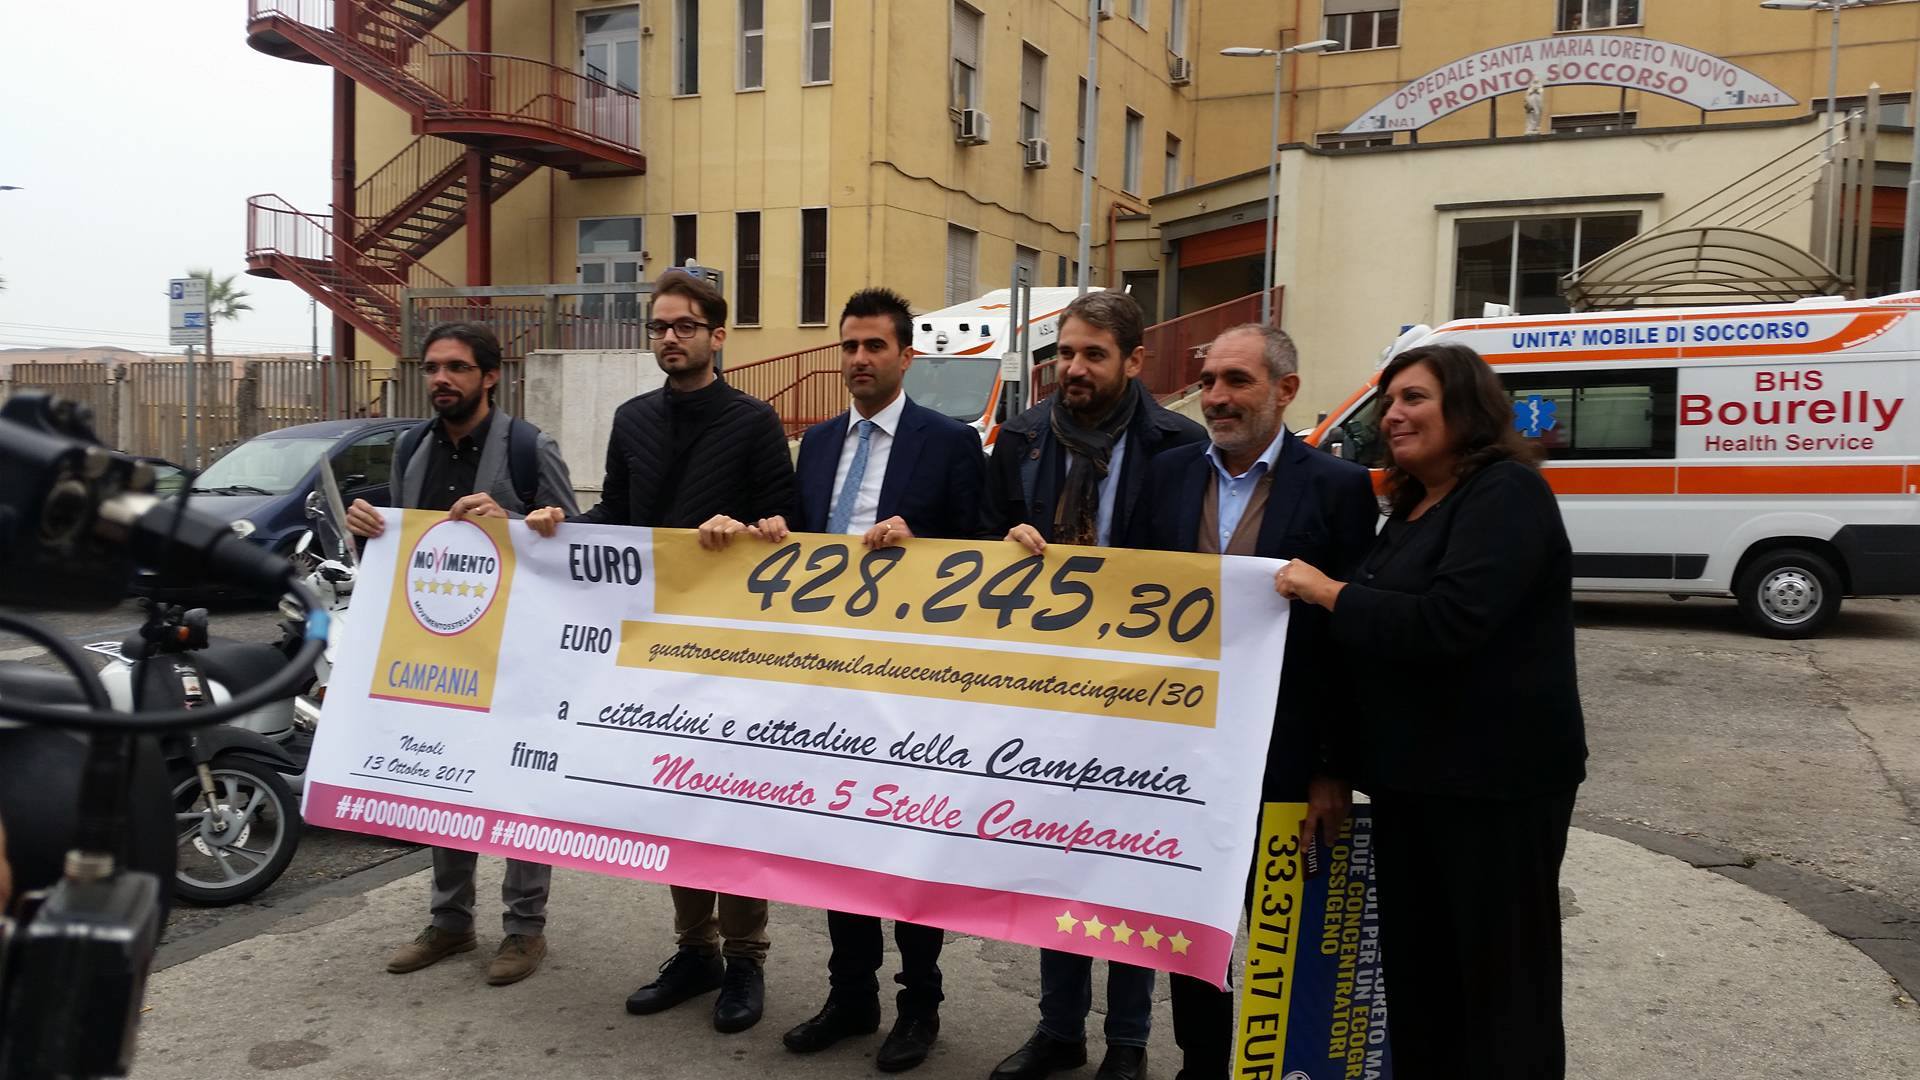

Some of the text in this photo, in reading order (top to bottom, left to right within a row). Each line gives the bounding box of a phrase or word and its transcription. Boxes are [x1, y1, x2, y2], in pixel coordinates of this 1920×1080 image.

[1395, 38, 1737, 109] OSPEDALE SANTA MARIA LORETO NUOVO
[1429, 61, 1688, 115] PRONTO SOCCORSO
[1583, 326, 1659, 346] MOBILE
[1666, 325, 1686, 342] DI
[1693, 321, 1809, 342] SOCCORSO
[1755, 370, 1824, 392] BHS
[1679, 390, 1904, 432] Bourelly
[1705, 433, 1875, 452] Health Service
[414, 546, 496, 575] MOVIMENTO
[569, 542, 1215, 643] EURO 428.245,30
[560, 623, 612, 654] EURO
[388, 660, 478, 697] CAMPANIA
[400, 734, 446, 755] Napoli
[558, 700, 1191, 795] a cittadini e cittadine della Campania
[363, 755, 475, 784] 13 Ottobre 2017
[511, 742, 1183, 859] firma Movimento 5 Stelle Campania
[1250, 834, 1299, 1000] 33.377,17
[1320, 845, 1350, 956] OSSIGENO
[1328, 817, 1372, 1059] E DUE CONCENTRATORI
[1358, 926, 1379, 965] PER
[1355, 970, 1374, 1000] UN
[1345, 1005, 1370, 1080] ECOGR
